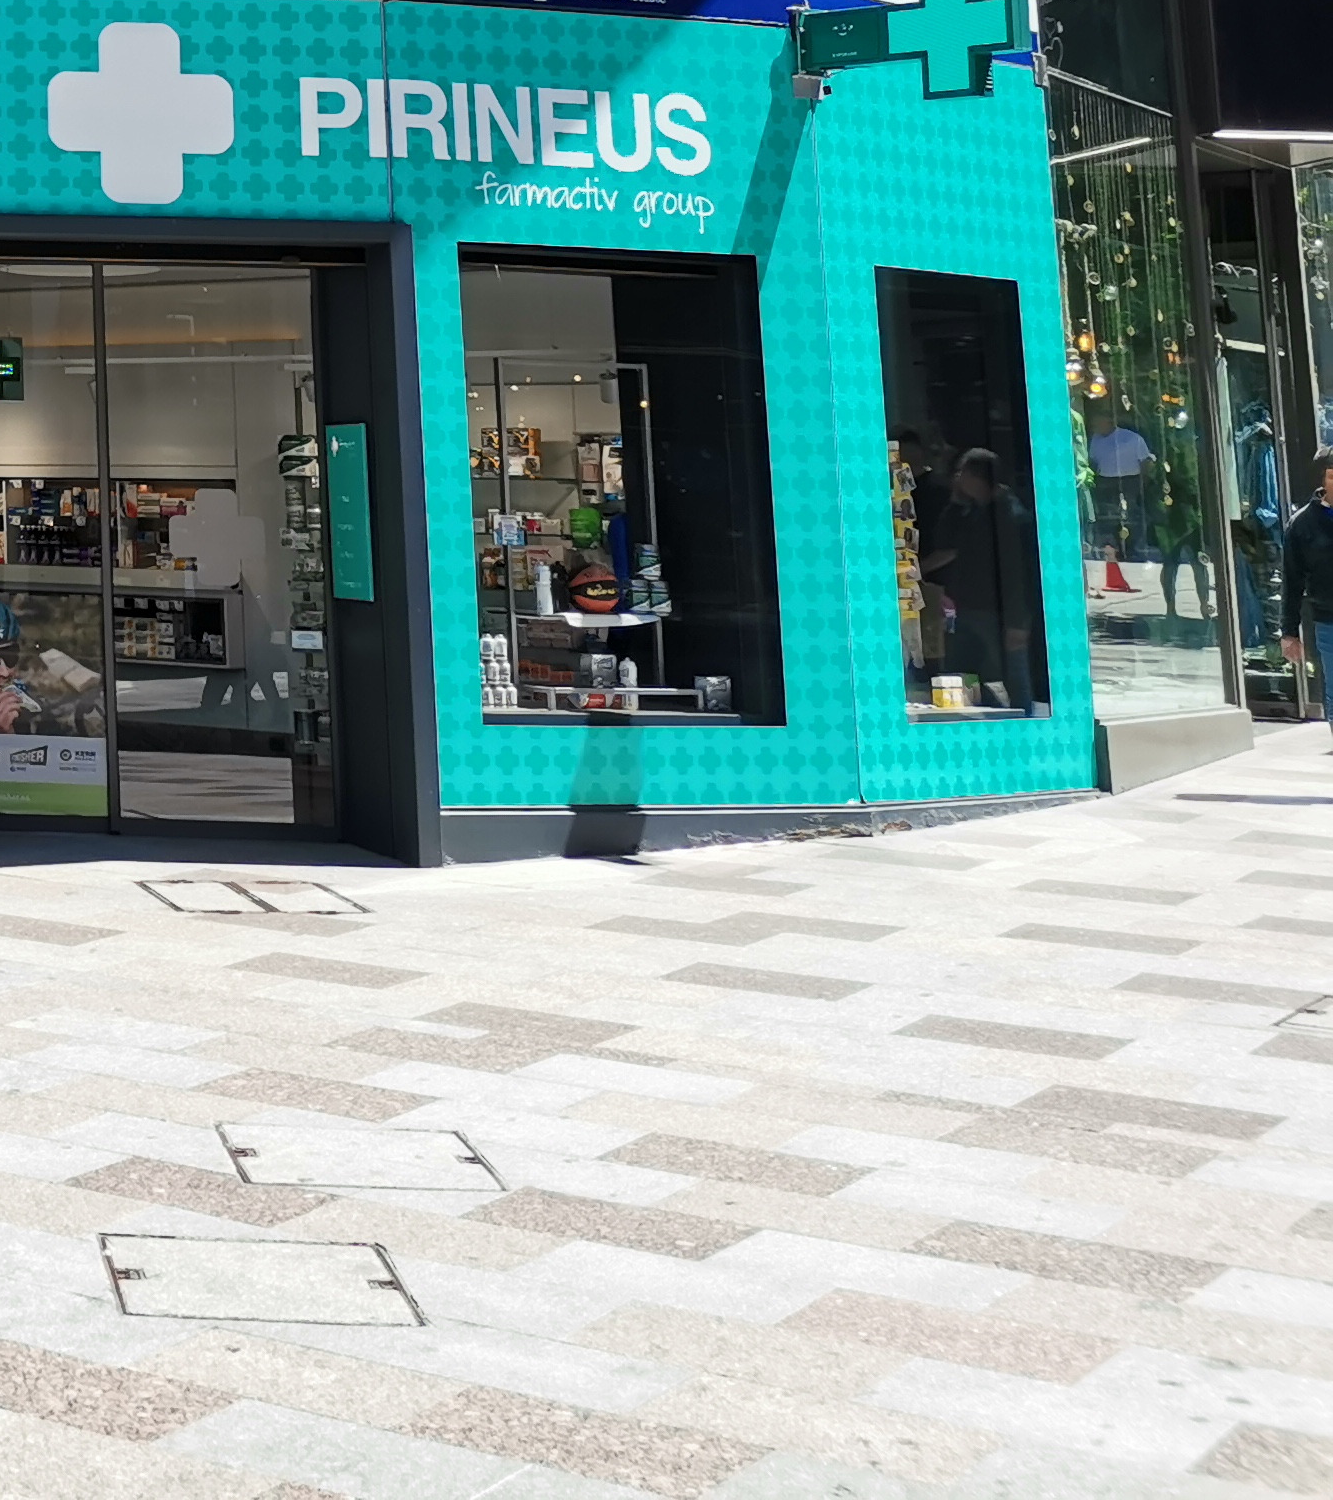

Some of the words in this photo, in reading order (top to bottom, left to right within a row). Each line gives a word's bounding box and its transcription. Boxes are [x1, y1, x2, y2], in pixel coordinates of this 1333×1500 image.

[299, 76, 712, 176] PIRINEUS
[475, 170, 619, 213] farmactiv
[633, 189, 715, 234] group
